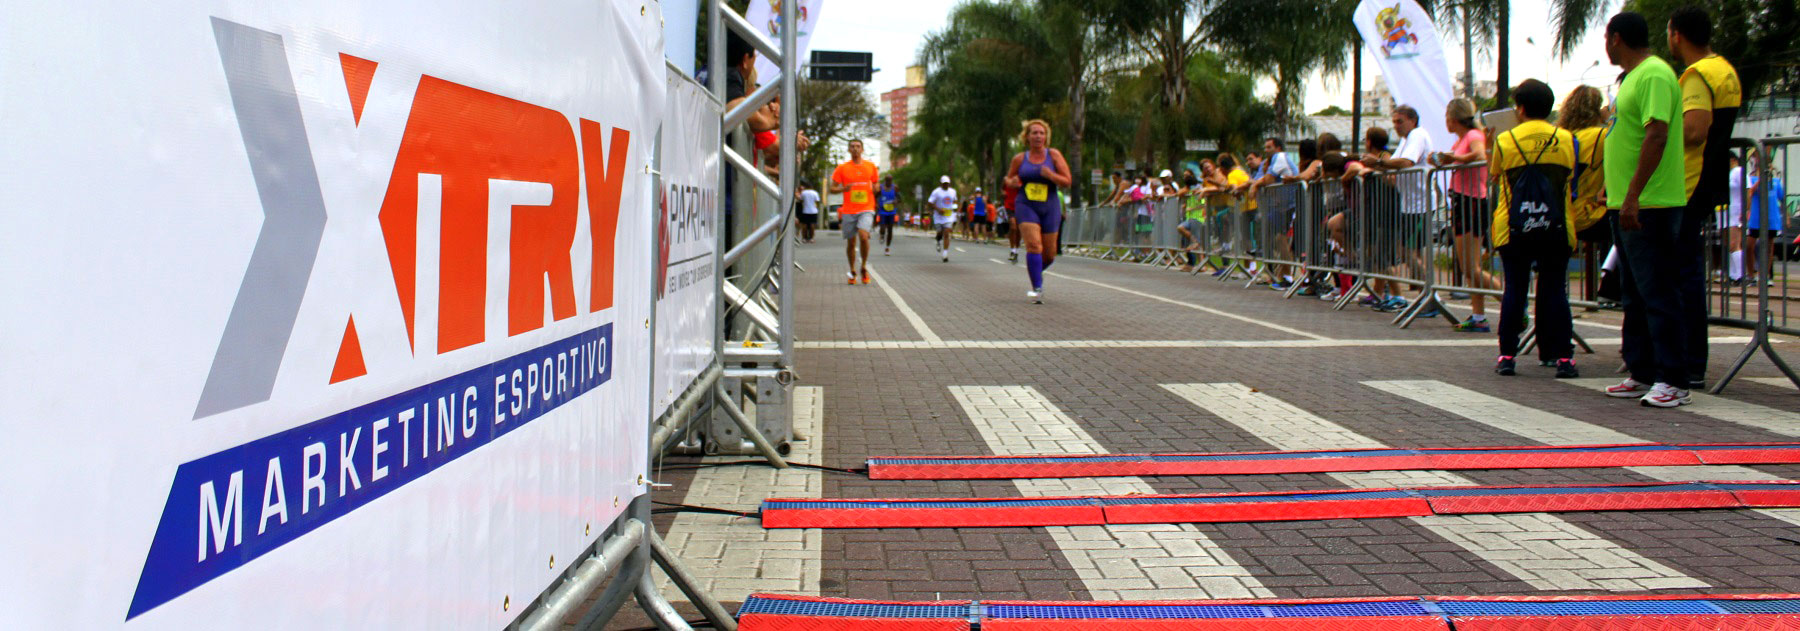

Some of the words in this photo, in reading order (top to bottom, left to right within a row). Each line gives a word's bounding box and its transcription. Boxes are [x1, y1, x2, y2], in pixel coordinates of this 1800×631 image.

[192, 15, 630, 421] XTRY
[1520, 200, 1549, 214] FILA
[198, 385, 478, 563] MARKETING
[495, 336, 607, 426] ESPORTIVO
